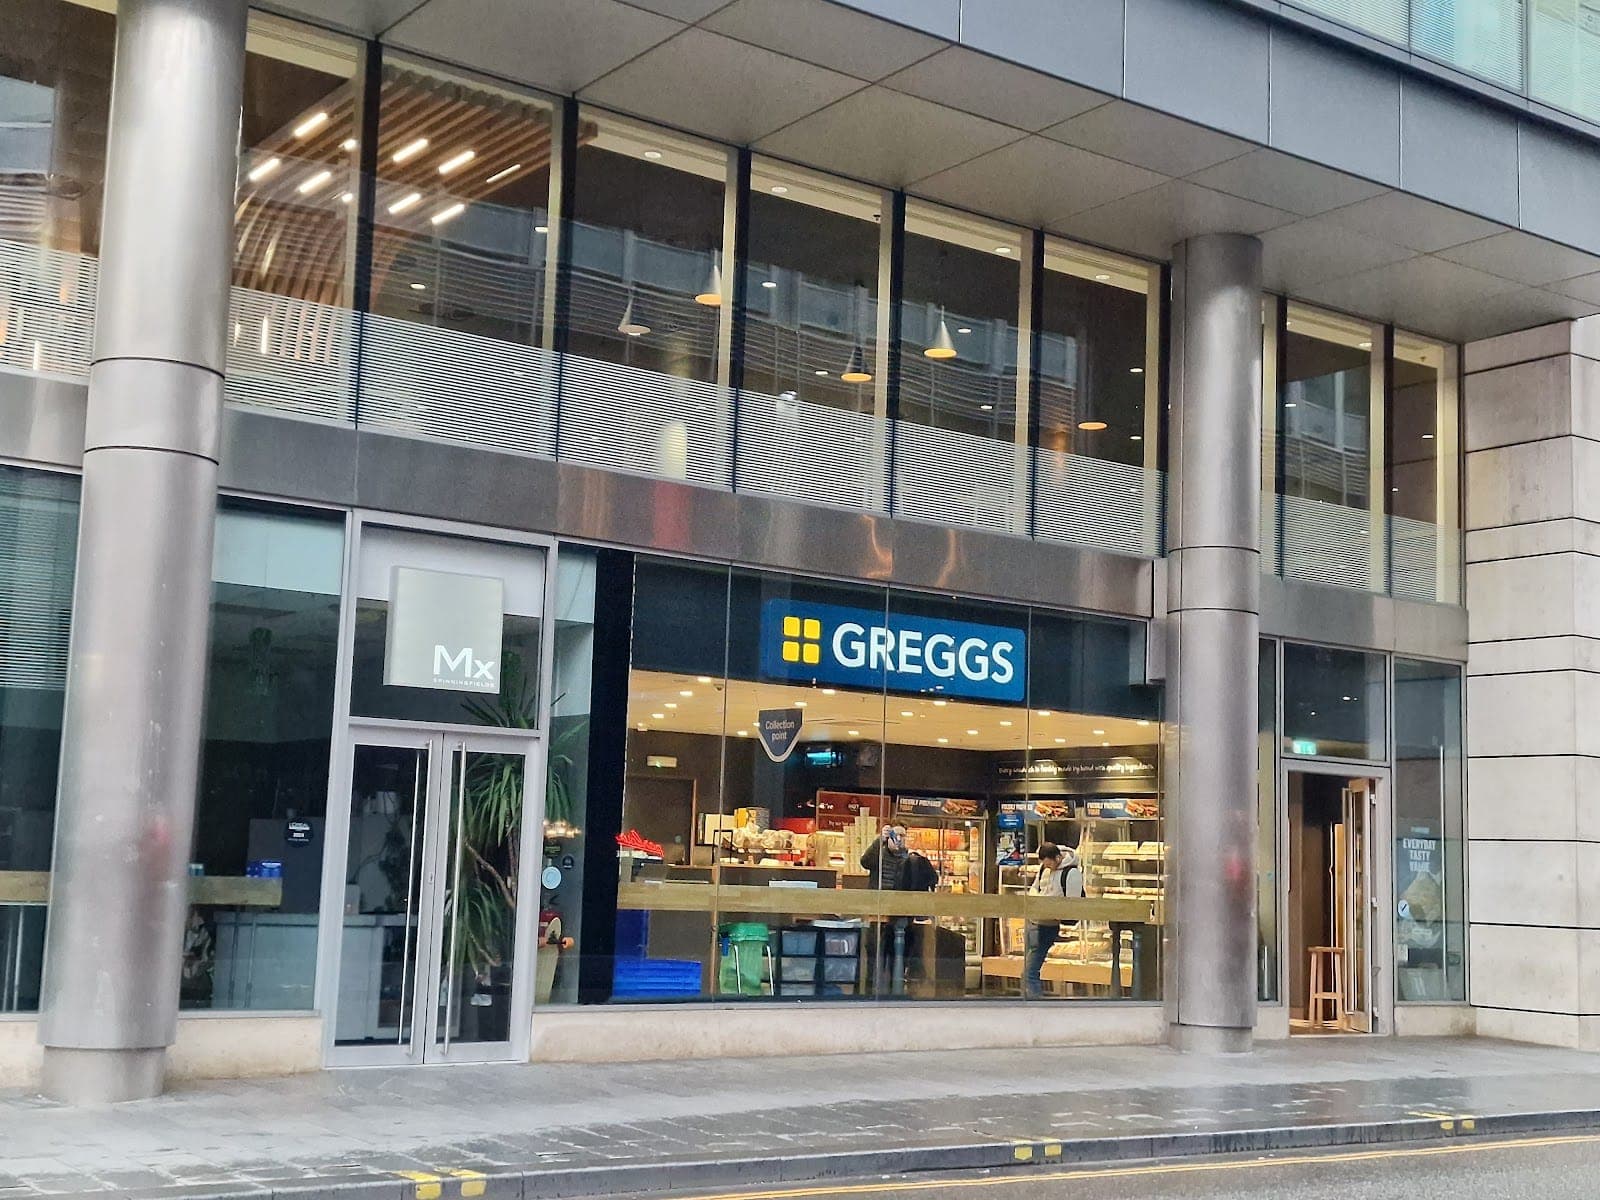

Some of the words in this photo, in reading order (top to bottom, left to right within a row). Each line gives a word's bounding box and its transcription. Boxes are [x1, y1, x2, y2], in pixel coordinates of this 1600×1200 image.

[831, 622, 1015, 685] GREGGS
[433, 645, 495, 680] Mx
[765, 719, 795, 731] Collection
[771, 731, 787, 742] point
[1403, 838, 1436, 850] EVERYDAY
[1409, 850, 1430, 861] TASTY
